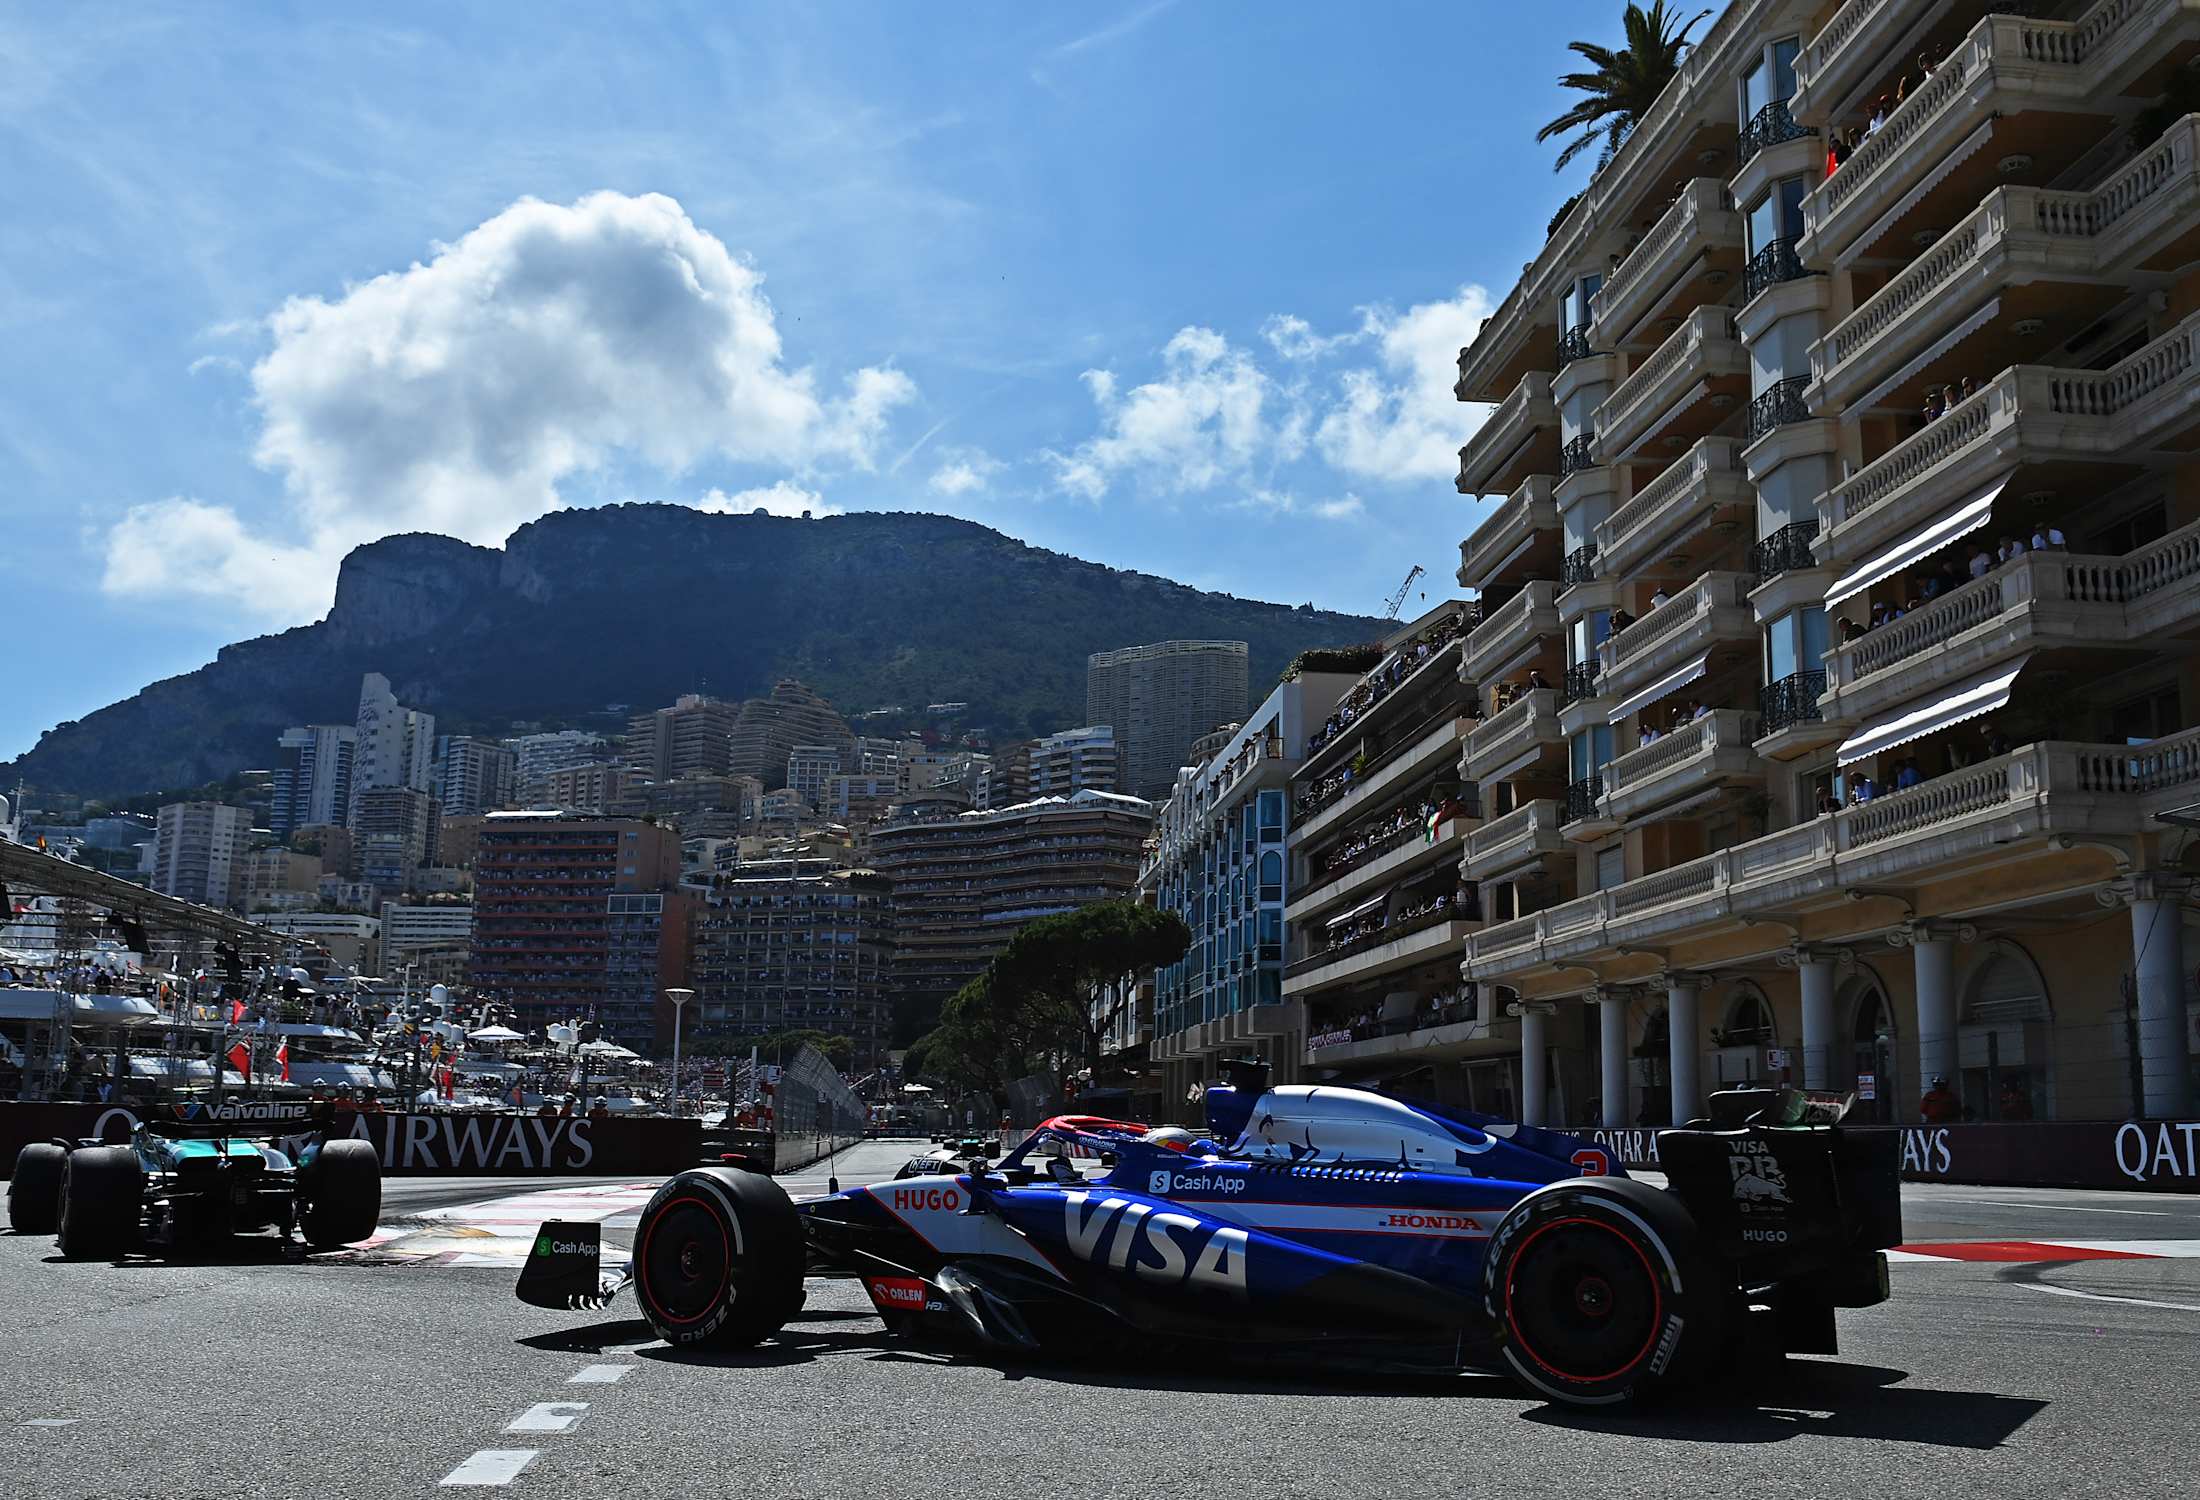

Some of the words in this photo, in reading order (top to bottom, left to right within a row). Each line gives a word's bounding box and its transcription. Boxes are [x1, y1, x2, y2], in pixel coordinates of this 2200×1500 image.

[205, 1103, 308, 1120] Valvoline
[1729, 1140, 1769, 1154] VISA
[911, 1158, 939, 1171] NEFT
[1173, 1174, 1211, 1192] Cash
[1213, 1175, 1246, 1196] App
[894, 1189, 959, 1211] HUGO
[1387, 1213, 1483, 1231] HONDA
[1064, 1190, 1249, 1290] VISA
[1743, 1229, 1789, 1243] HUGO
[552, 1240, 577, 1255] Cash
[578, 1241, 598, 1256] App
[1484, 1208, 1532, 1291] ZERO
[889, 1288, 923, 1302] ORLEN
[680, 1304, 729, 1343] ZERO
